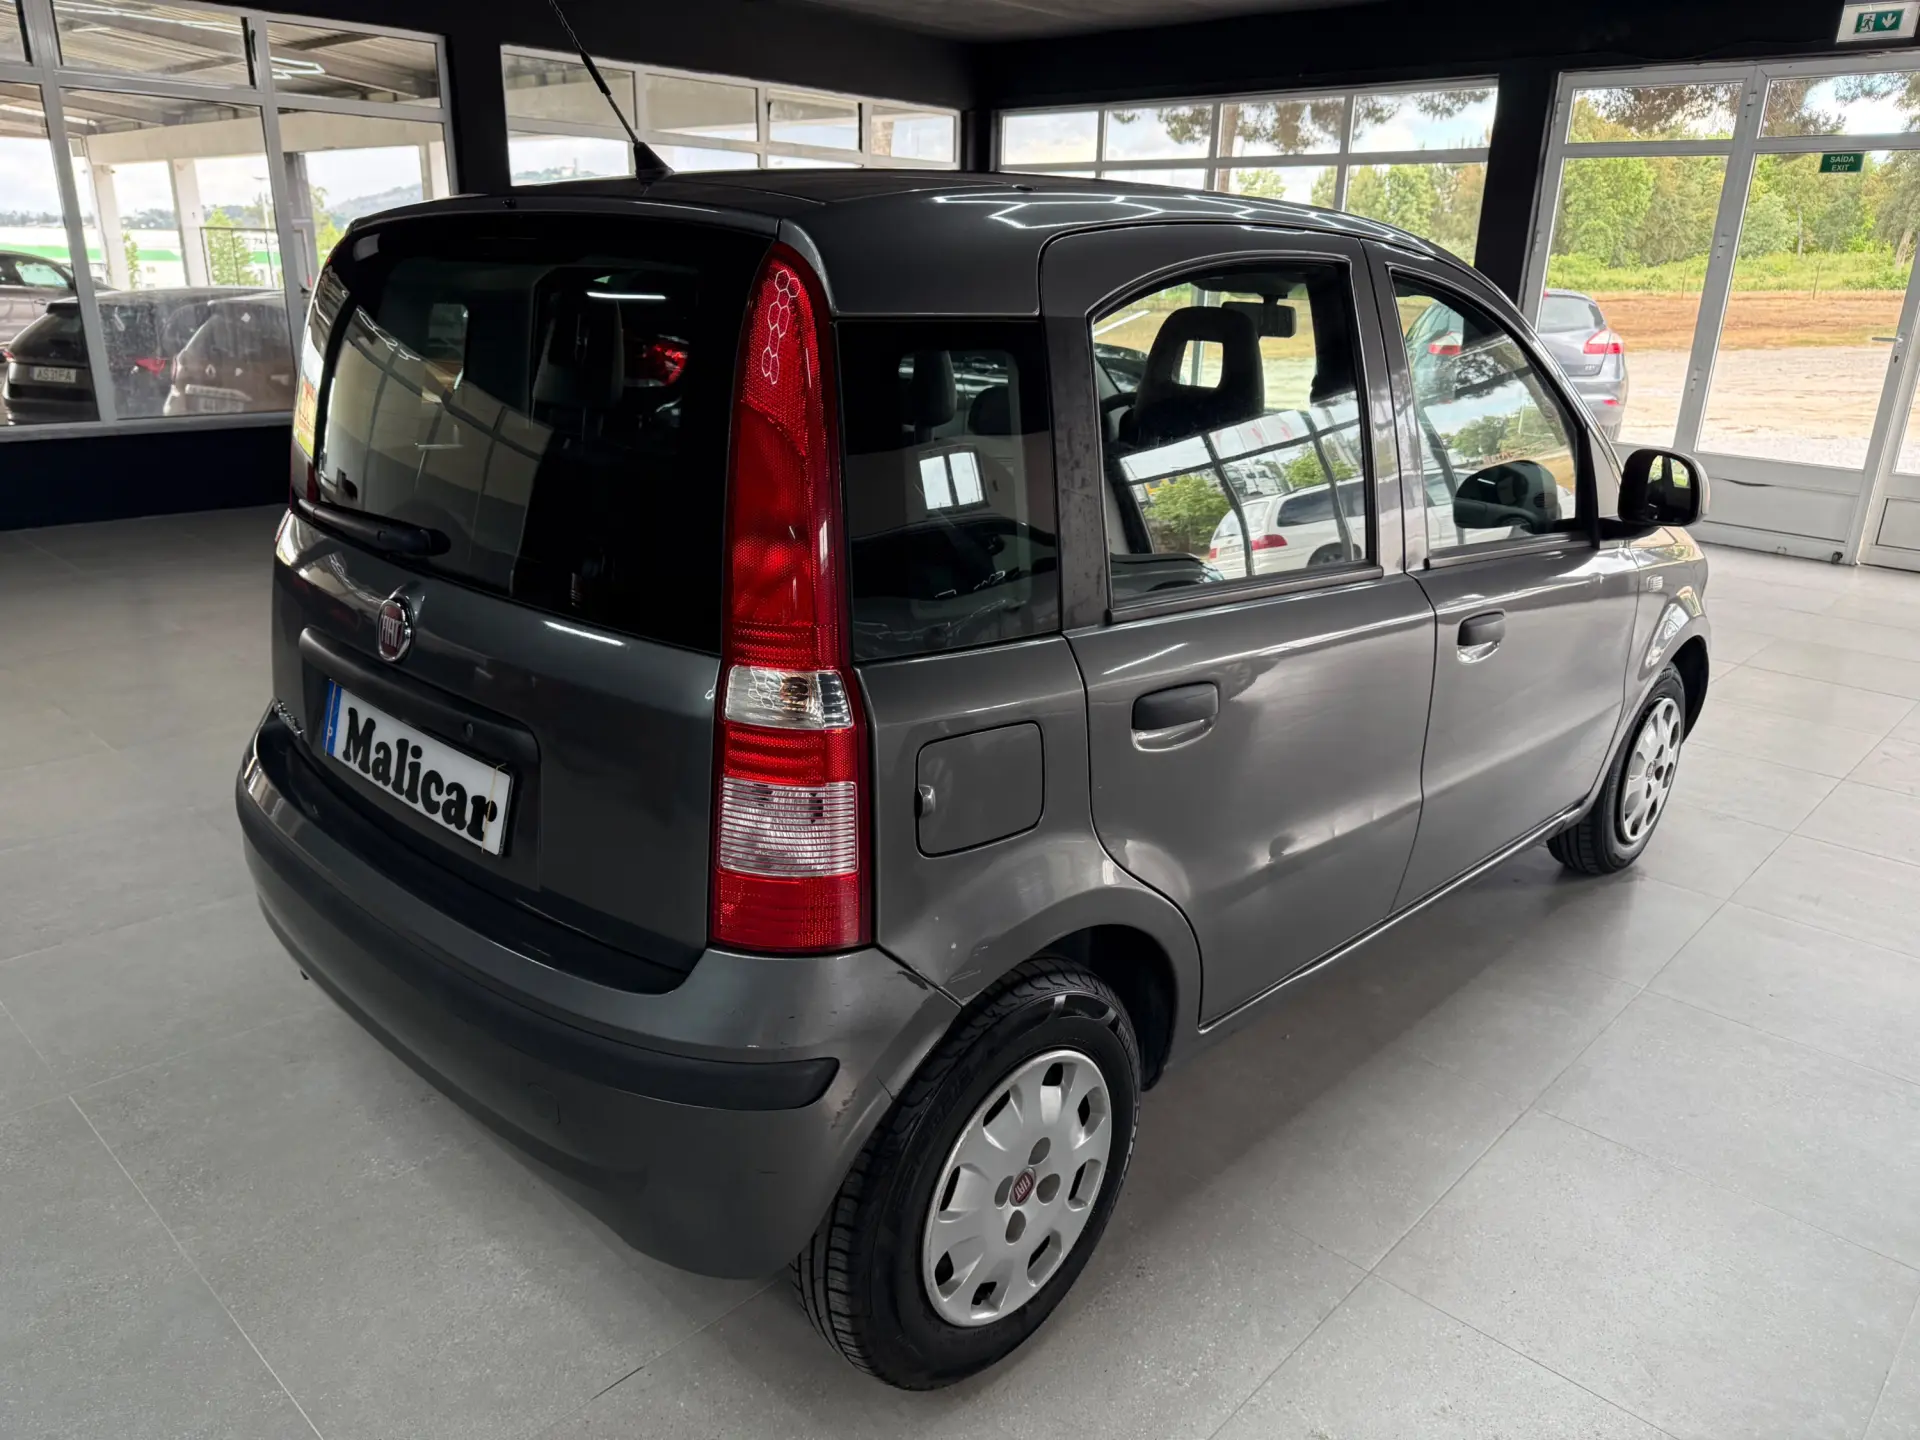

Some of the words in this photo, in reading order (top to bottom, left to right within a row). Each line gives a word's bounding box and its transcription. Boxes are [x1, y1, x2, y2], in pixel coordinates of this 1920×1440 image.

[1830, 155, 1855, 163] SAÍDA
[381, 615, 402, 648] FIAT
[342, 707, 497, 841] Malicar
[1014, 1175, 1031, 1200] FIAT
